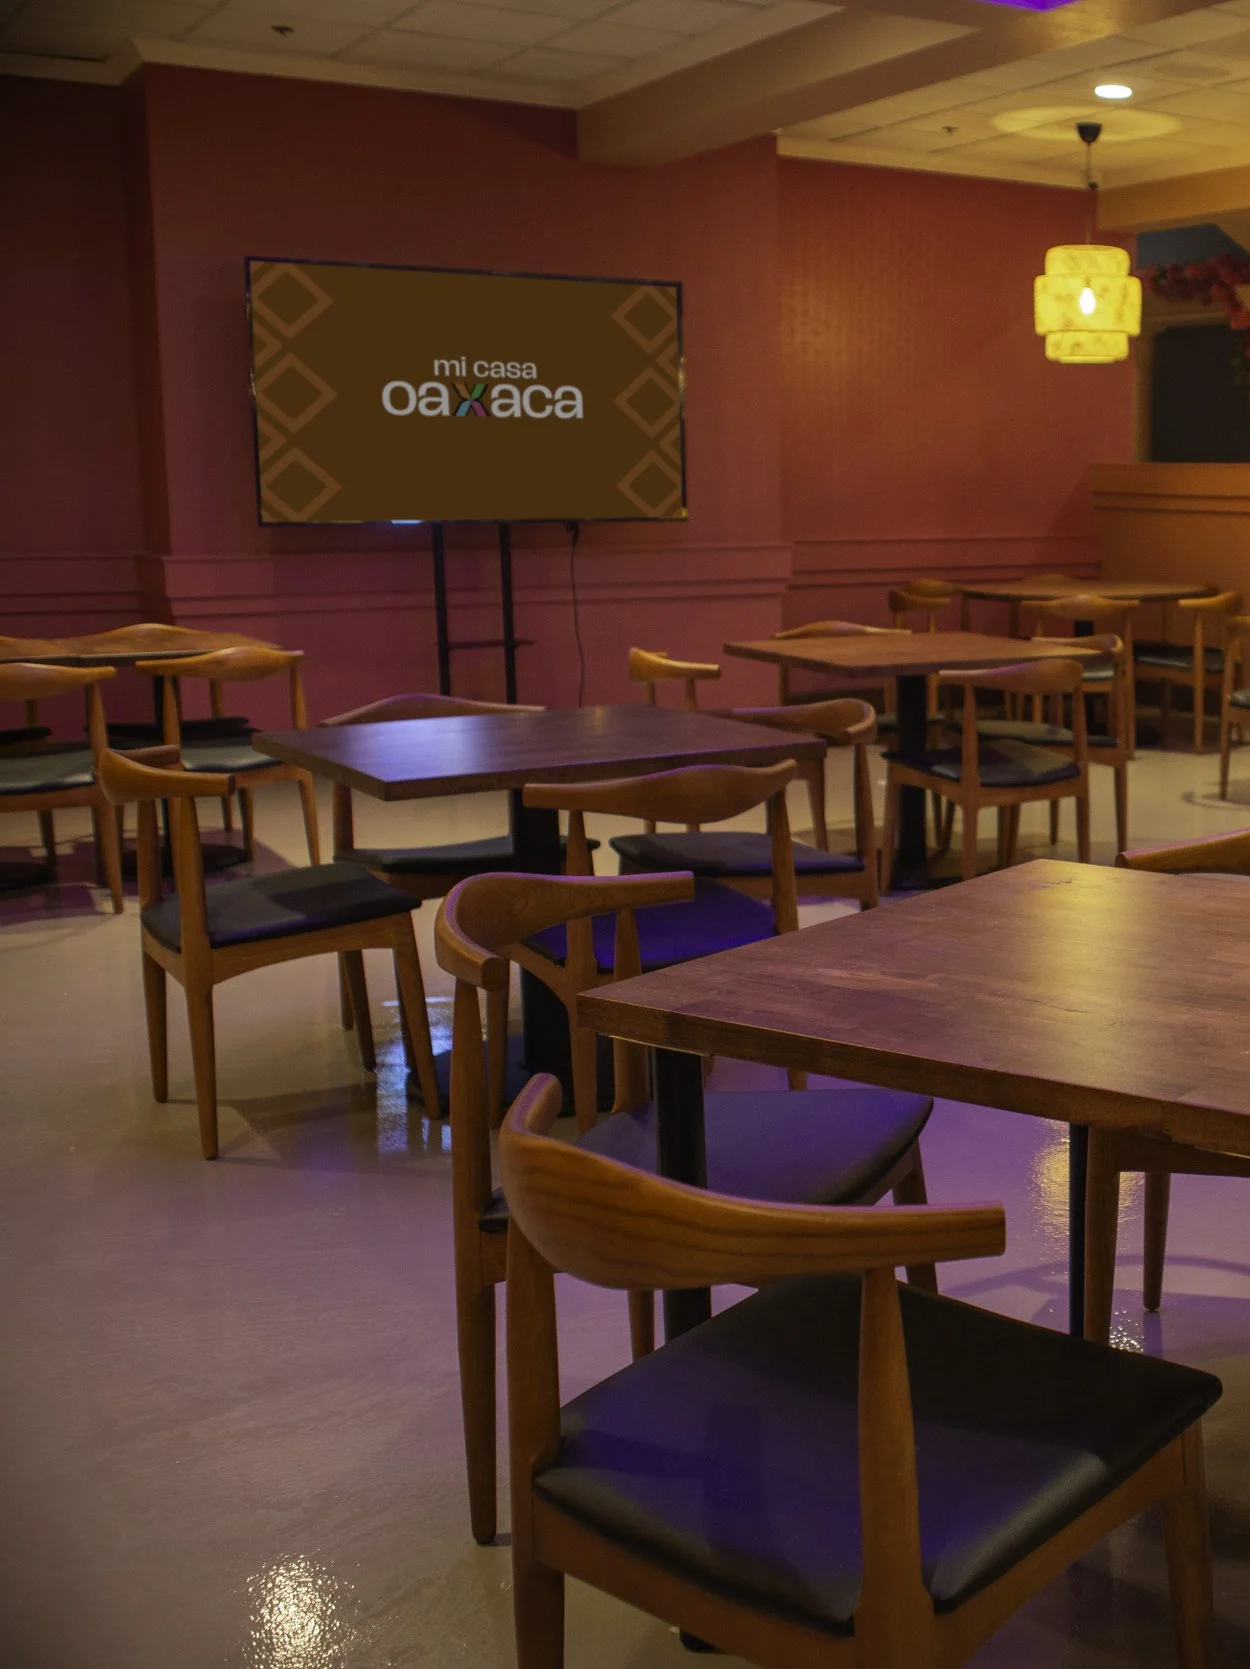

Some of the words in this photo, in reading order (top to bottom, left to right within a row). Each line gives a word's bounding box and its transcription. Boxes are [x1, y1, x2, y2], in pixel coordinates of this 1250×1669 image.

[433, 356, 467, 378] mi
[473, 360, 537, 379] casa
[381, 380, 584, 419] oaxaca
